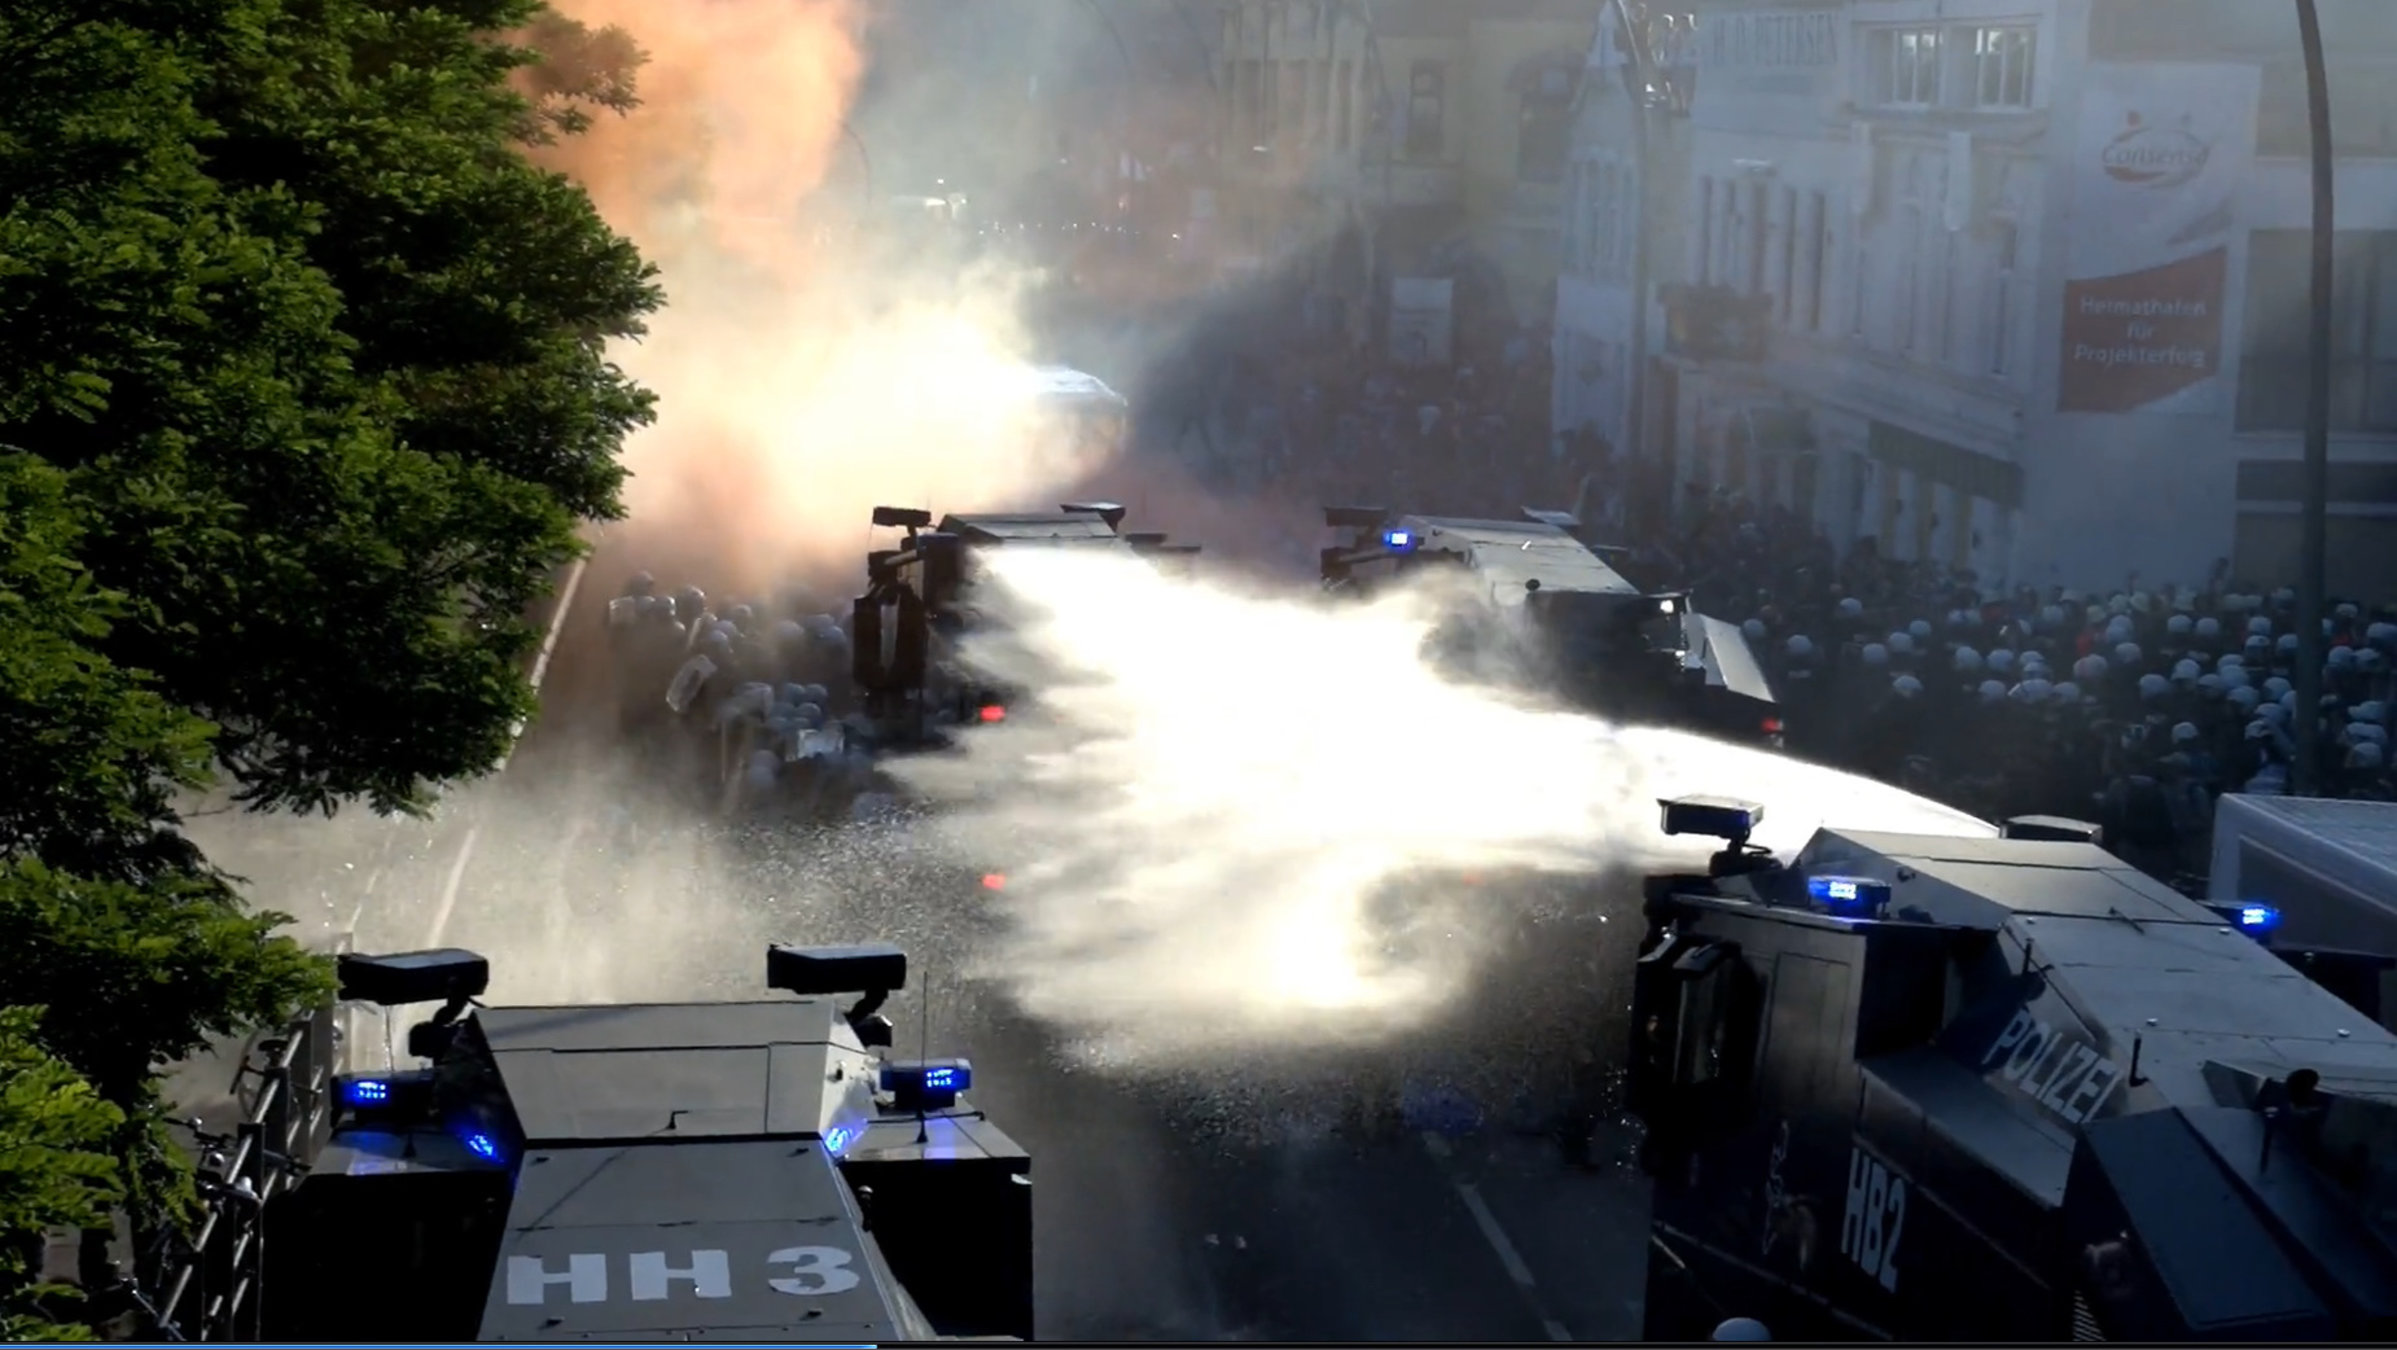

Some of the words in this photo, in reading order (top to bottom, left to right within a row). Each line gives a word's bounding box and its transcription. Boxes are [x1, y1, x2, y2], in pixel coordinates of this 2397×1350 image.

[2079, 297, 2207, 316] Heimathafen
[2127, 320, 2155, 340] für
[2074, 344, 2206, 368] Projekterfolg
[1982, 1009, 2124, 1123] POLIZEI
[1841, 1147, 1906, 1294] HB2
[507, 1250, 732, 1304] HH
[767, 1246, 860, 1295] 3
